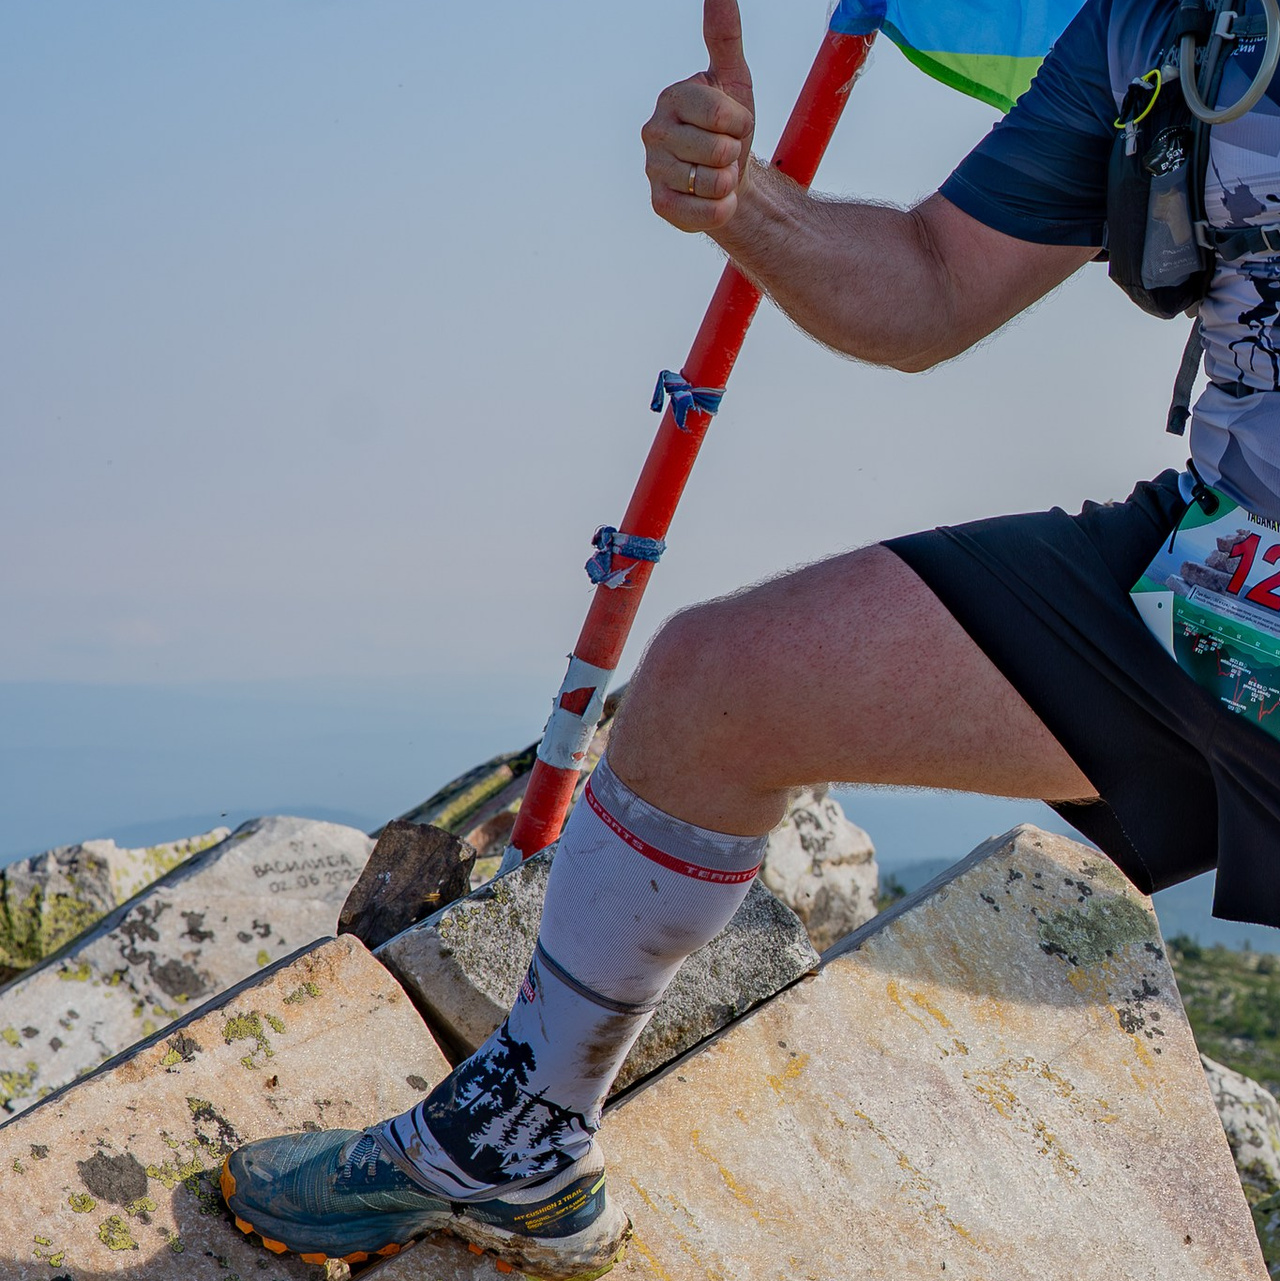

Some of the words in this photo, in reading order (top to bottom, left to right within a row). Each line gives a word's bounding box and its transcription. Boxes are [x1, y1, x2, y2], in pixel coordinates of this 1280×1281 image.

[588, 793, 644, 850] SPORTS
[685, 865, 760, 882] TERRITO
[525, 1203, 557, 1218] CUSHION
[562, 1189, 583, 1202] TRAIL
